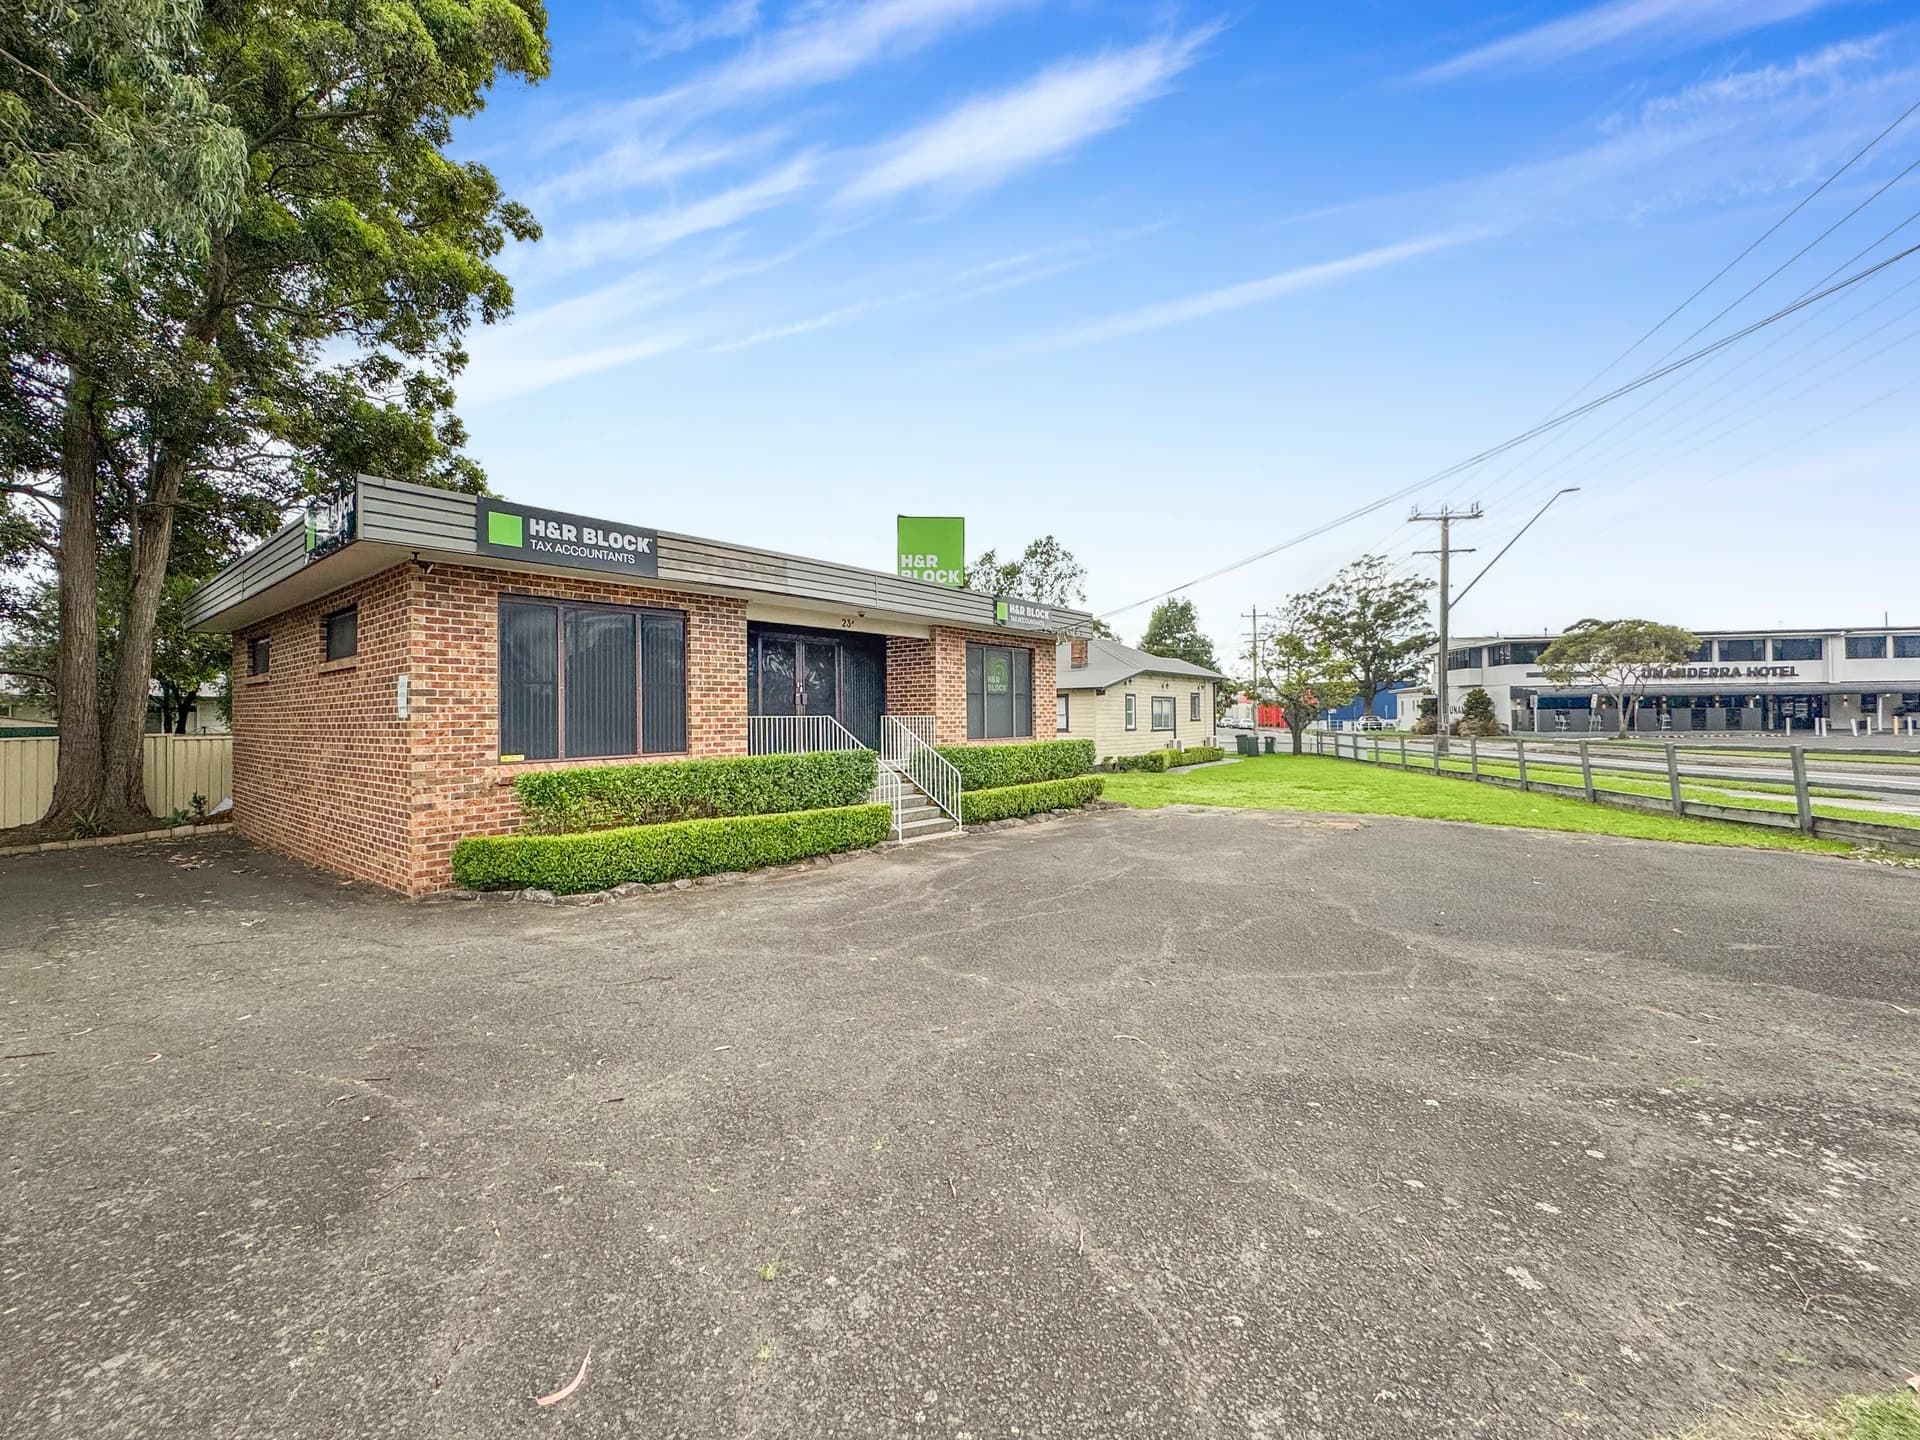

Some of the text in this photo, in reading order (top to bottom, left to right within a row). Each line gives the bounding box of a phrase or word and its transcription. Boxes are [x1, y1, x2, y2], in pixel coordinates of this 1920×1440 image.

[529, 517, 651, 554] H&R BLOCK
[529, 538, 636, 565] TAX ACCOUNTANTS
[900, 553, 938, 568] H&R
[1009, 602, 1050, 620] H&R BLOCK
[1746, 665, 1799, 678] HOTEL
